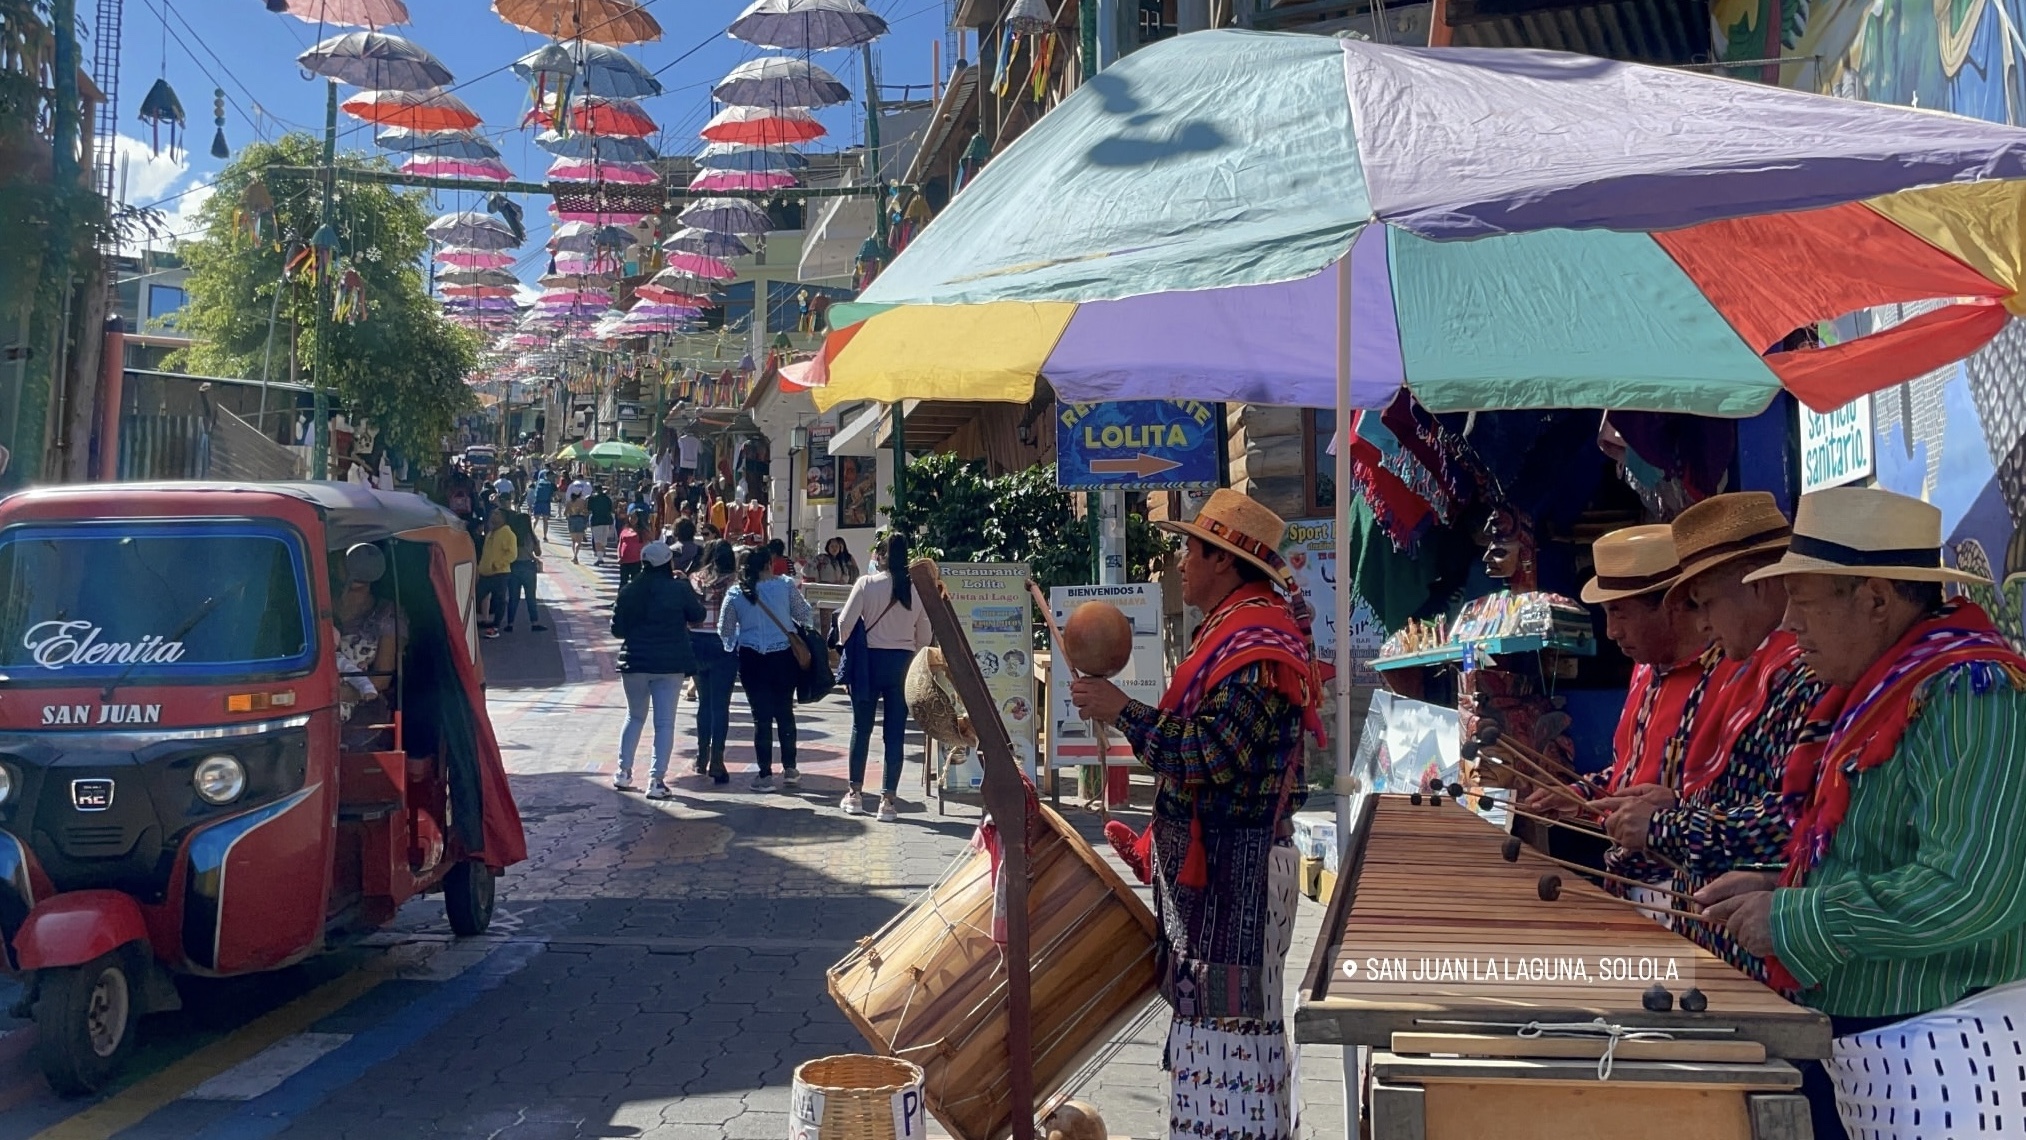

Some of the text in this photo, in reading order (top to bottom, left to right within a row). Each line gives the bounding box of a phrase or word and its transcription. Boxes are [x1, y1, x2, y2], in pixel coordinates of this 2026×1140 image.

[1085, 424, 1188, 448] LOLITA
[1806, 424, 1867, 487] sanitario.
[1289, 523, 1328, 543] Sport
[940, 567, 1025, 576] Restaurante
[962, 579, 1006, 589] Lolita
[1067, 586, 1144, 597] BIENVENIDOS A
[991, 593, 1019, 602] Lago
[23, 620, 185, 670] Elenita
[41, 704, 161, 725] SAN JUAN
